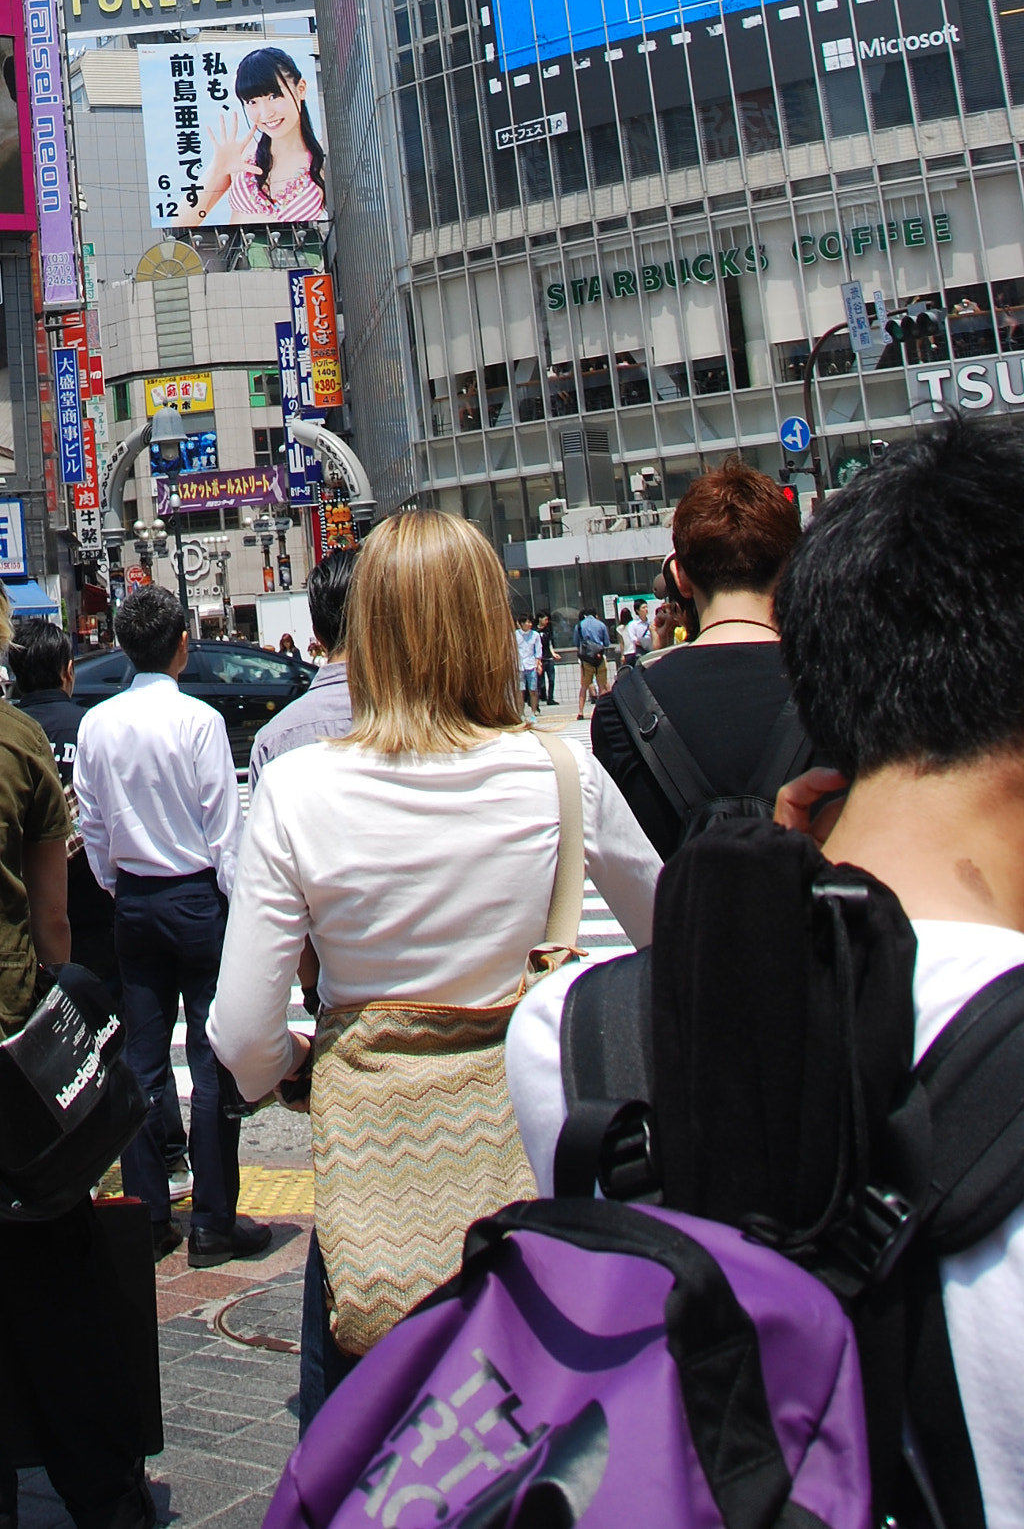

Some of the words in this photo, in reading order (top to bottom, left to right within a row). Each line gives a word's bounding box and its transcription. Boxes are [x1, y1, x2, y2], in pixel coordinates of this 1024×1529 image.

[859, 22, 960, 61] Microsoft
[202, 52, 230, 111] 私も、
[170, 54, 207, 218] 前島亜美です。
[501, 124, 543, 144] サーフェス
[37, 116, 61, 213] neon
[46, 264, 72, 277] 3719
[47, 254, 70, 264] (03)
[48, 275, 72, 286] 2468
[547, 243, 769, 312] STARBUCKS
[790, 212, 953, 266] COFFEE
[917, 358, 1024, 414] TSU
[58, 357, 81, 474] 大盛堂商事ビル
[177, 473, 270, 501] スケットボールストリート
